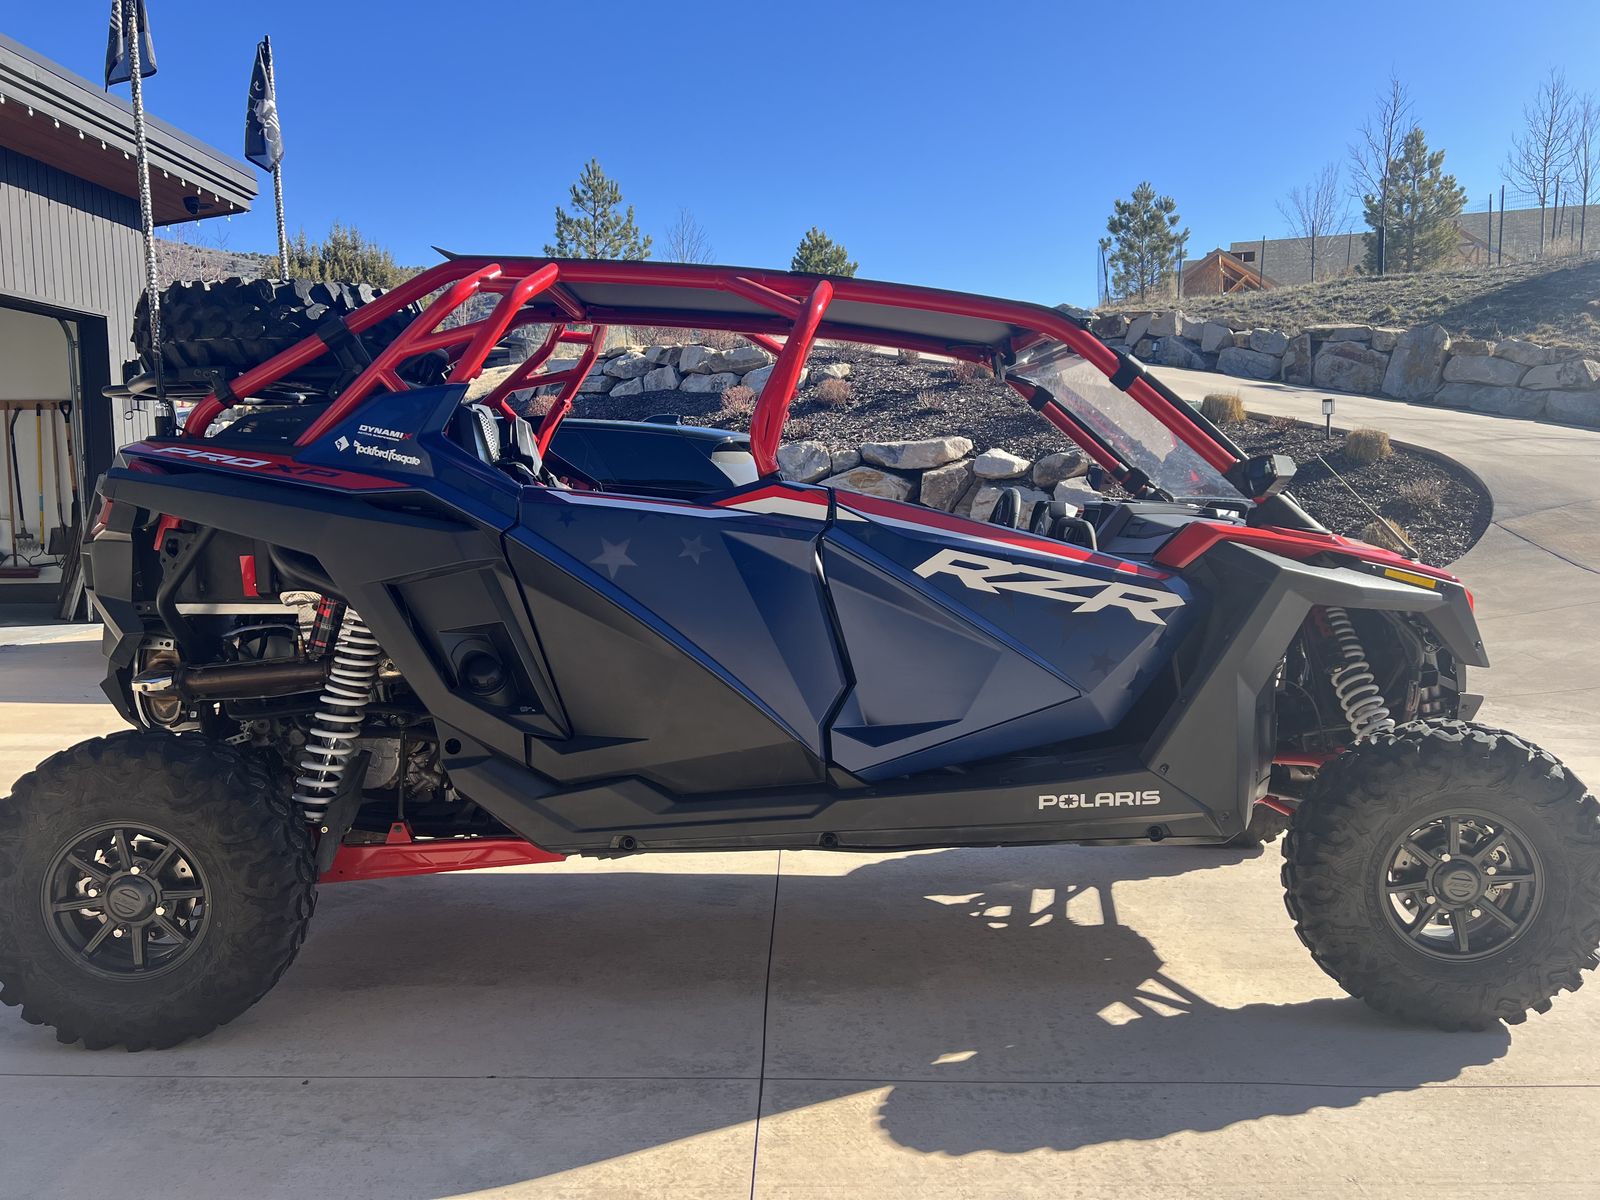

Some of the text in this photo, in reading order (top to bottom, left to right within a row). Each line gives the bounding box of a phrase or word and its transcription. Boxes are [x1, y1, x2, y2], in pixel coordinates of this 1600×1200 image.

[359, 424, 414, 440] DYNAMIX
[152, 447, 272, 468] PRO
[913, 548, 1186, 626] RZR
[1038, 790, 1161, 810] POLARIS
